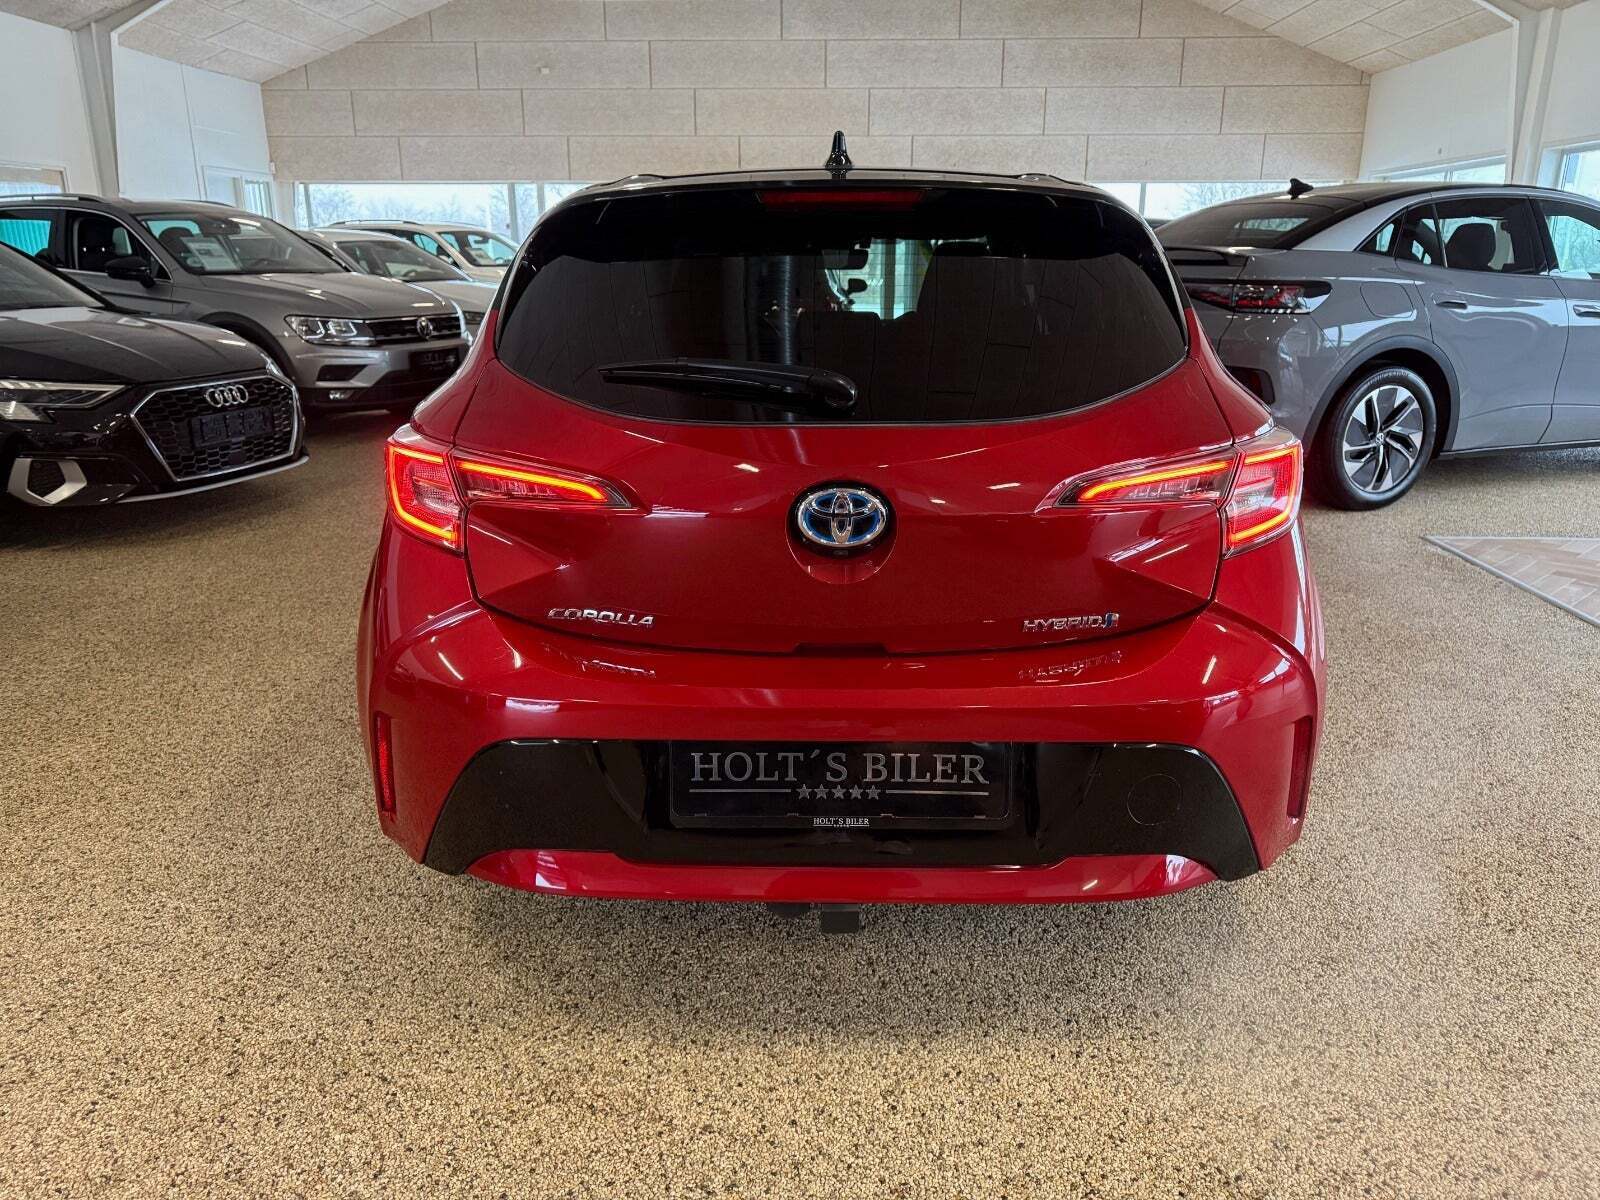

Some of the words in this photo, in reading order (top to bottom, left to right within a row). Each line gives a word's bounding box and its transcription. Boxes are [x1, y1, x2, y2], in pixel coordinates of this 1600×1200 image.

[547, 607, 655, 627] COROLLA
[1023, 615, 1103, 632] HYBRID
[863, 752, 990, 785] BILER
[845, 817, 870, 825] BILER
